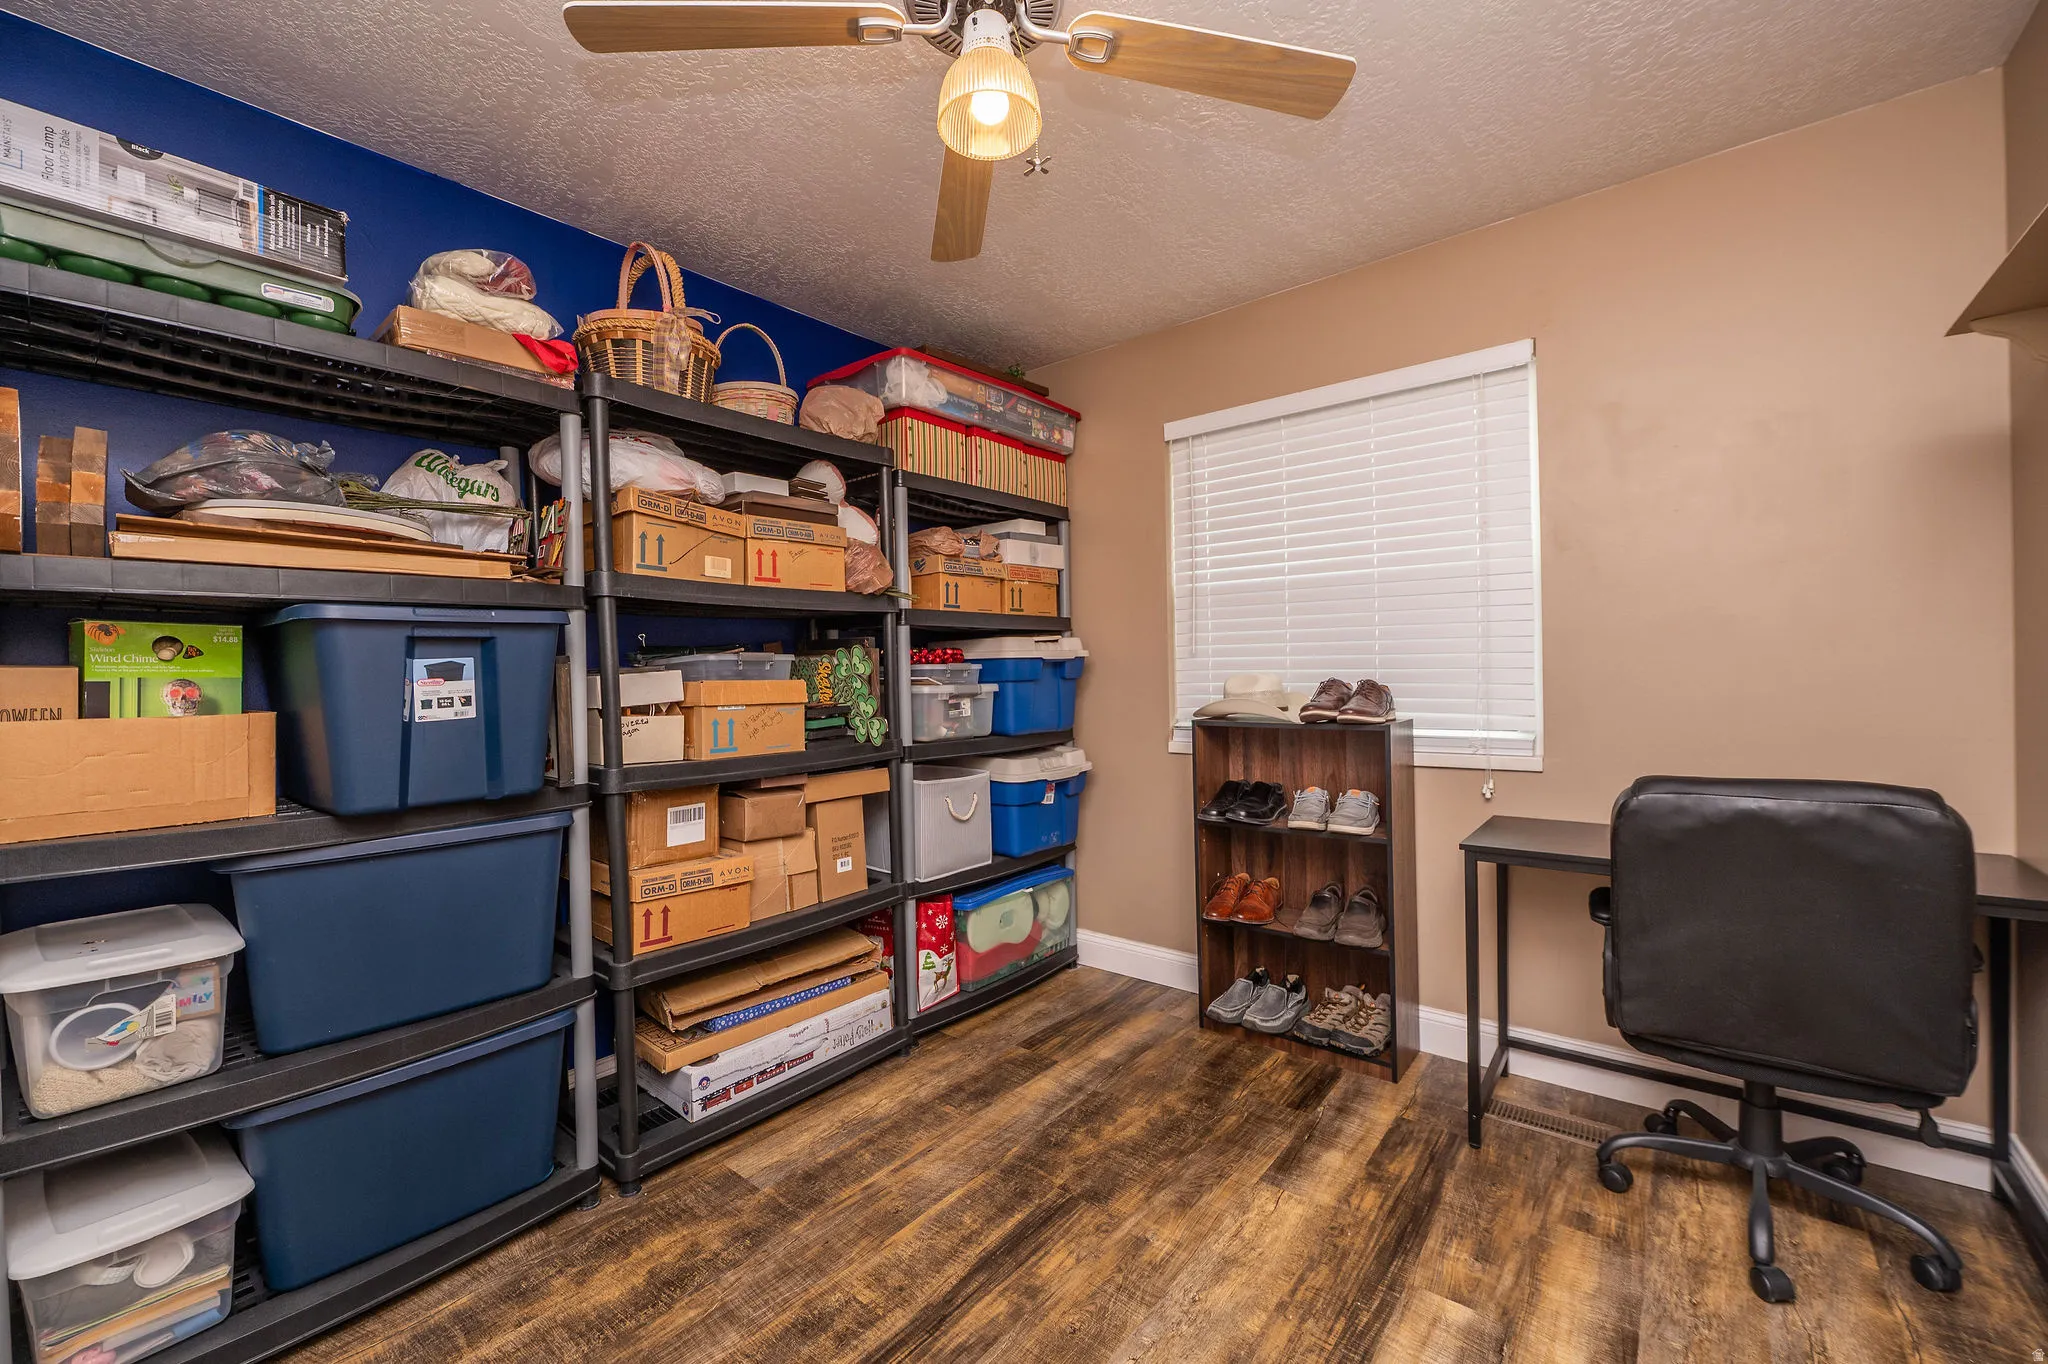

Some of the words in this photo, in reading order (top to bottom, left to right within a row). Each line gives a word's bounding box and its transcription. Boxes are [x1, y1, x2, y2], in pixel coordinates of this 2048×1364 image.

[2, 117, 12, 158] MAINSTAYS
[41, 125, 57, 154] Lamp
[59, 128, 70, 149] Table
[131, 143, 150, 154] Black
[41, 155, 54, 181] Floor
[640, 499, 670, 511] ORM-D
[711, 514, 741, 526] AVON
[756, 525, 782, 535] ORM-D
[820, 532, 842, 540] AVON
[213, 635, 239, 643] $14.88
[89, 653, 121, 664] Wind
[622, 727, 640, 738] agon
[719, 866, 751, 878] AVON
[643, 883, 675, 896] ORM-D
[682, 876, 712, 889] ORM-D-AIR
